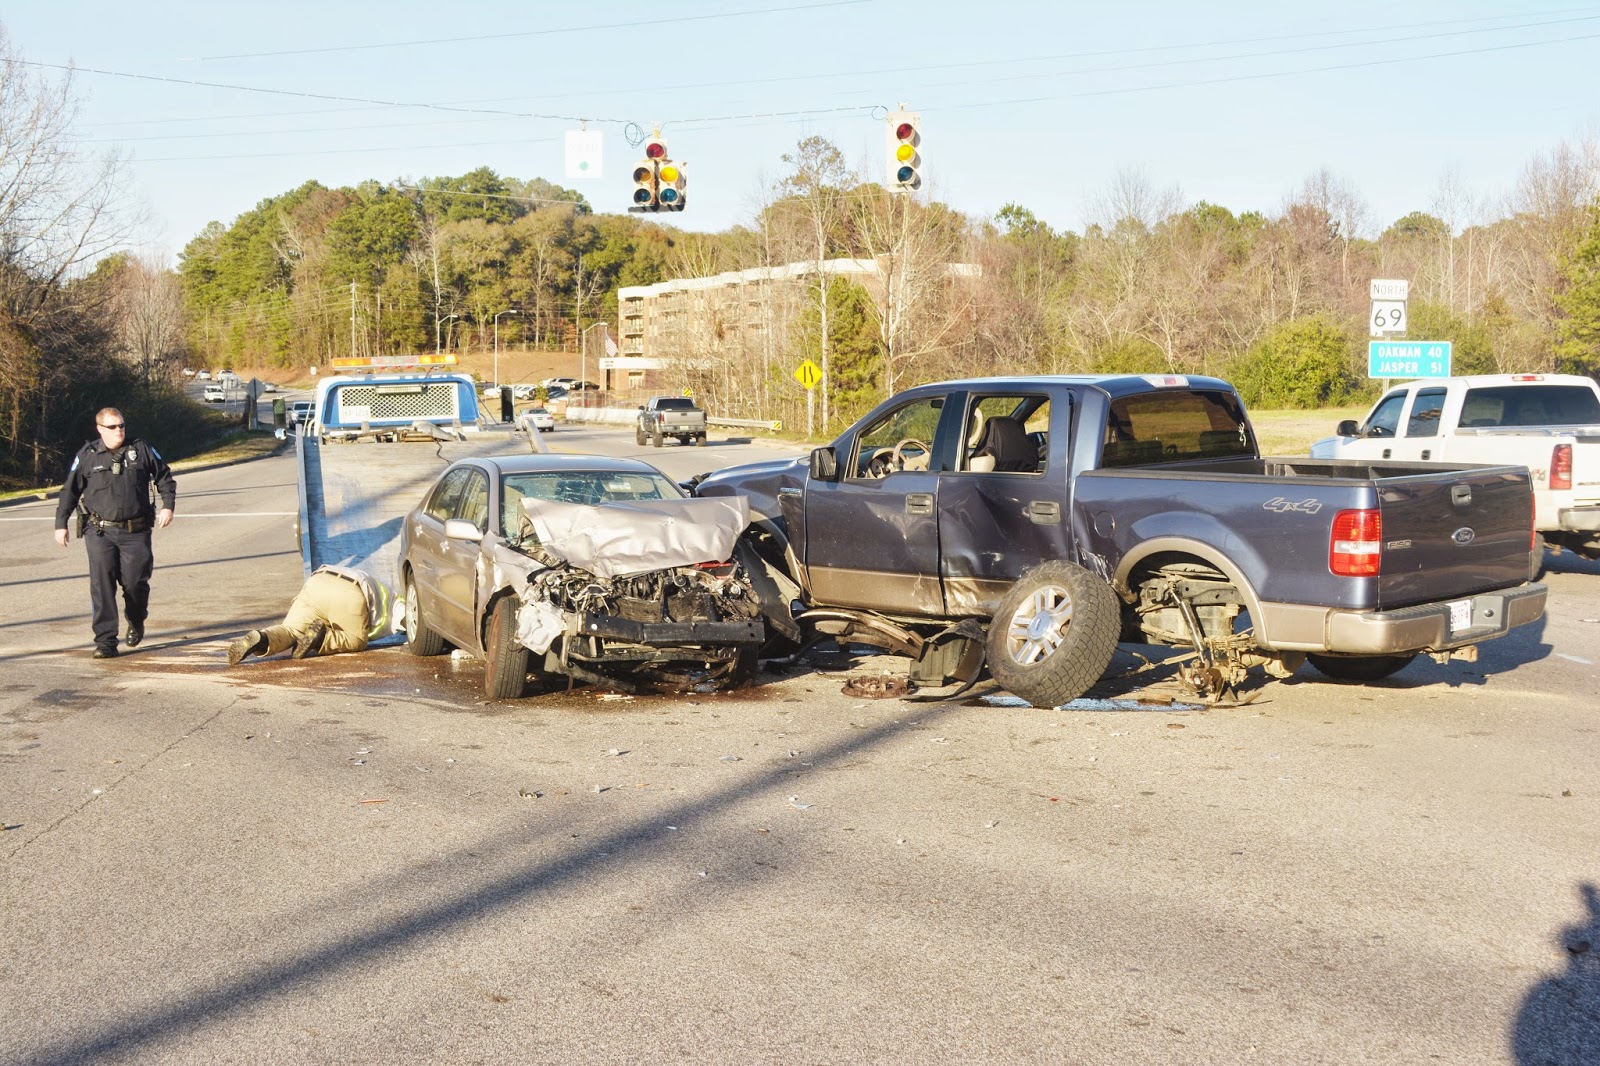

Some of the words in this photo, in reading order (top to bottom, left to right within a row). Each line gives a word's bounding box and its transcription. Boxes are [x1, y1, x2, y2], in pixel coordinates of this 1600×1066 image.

[1373, 283, 1405, 295] NORTH
[1374, 308, 1402, 328] 69
[1378, 346, 1421, 358] OAKMAN
[1427, 346, 1443, 358] 40
[1378, 361, 1418, 374] JASPER
[1430, 361, 1443, 374] 51
[1262, 496, 1322, 514] 4x4
